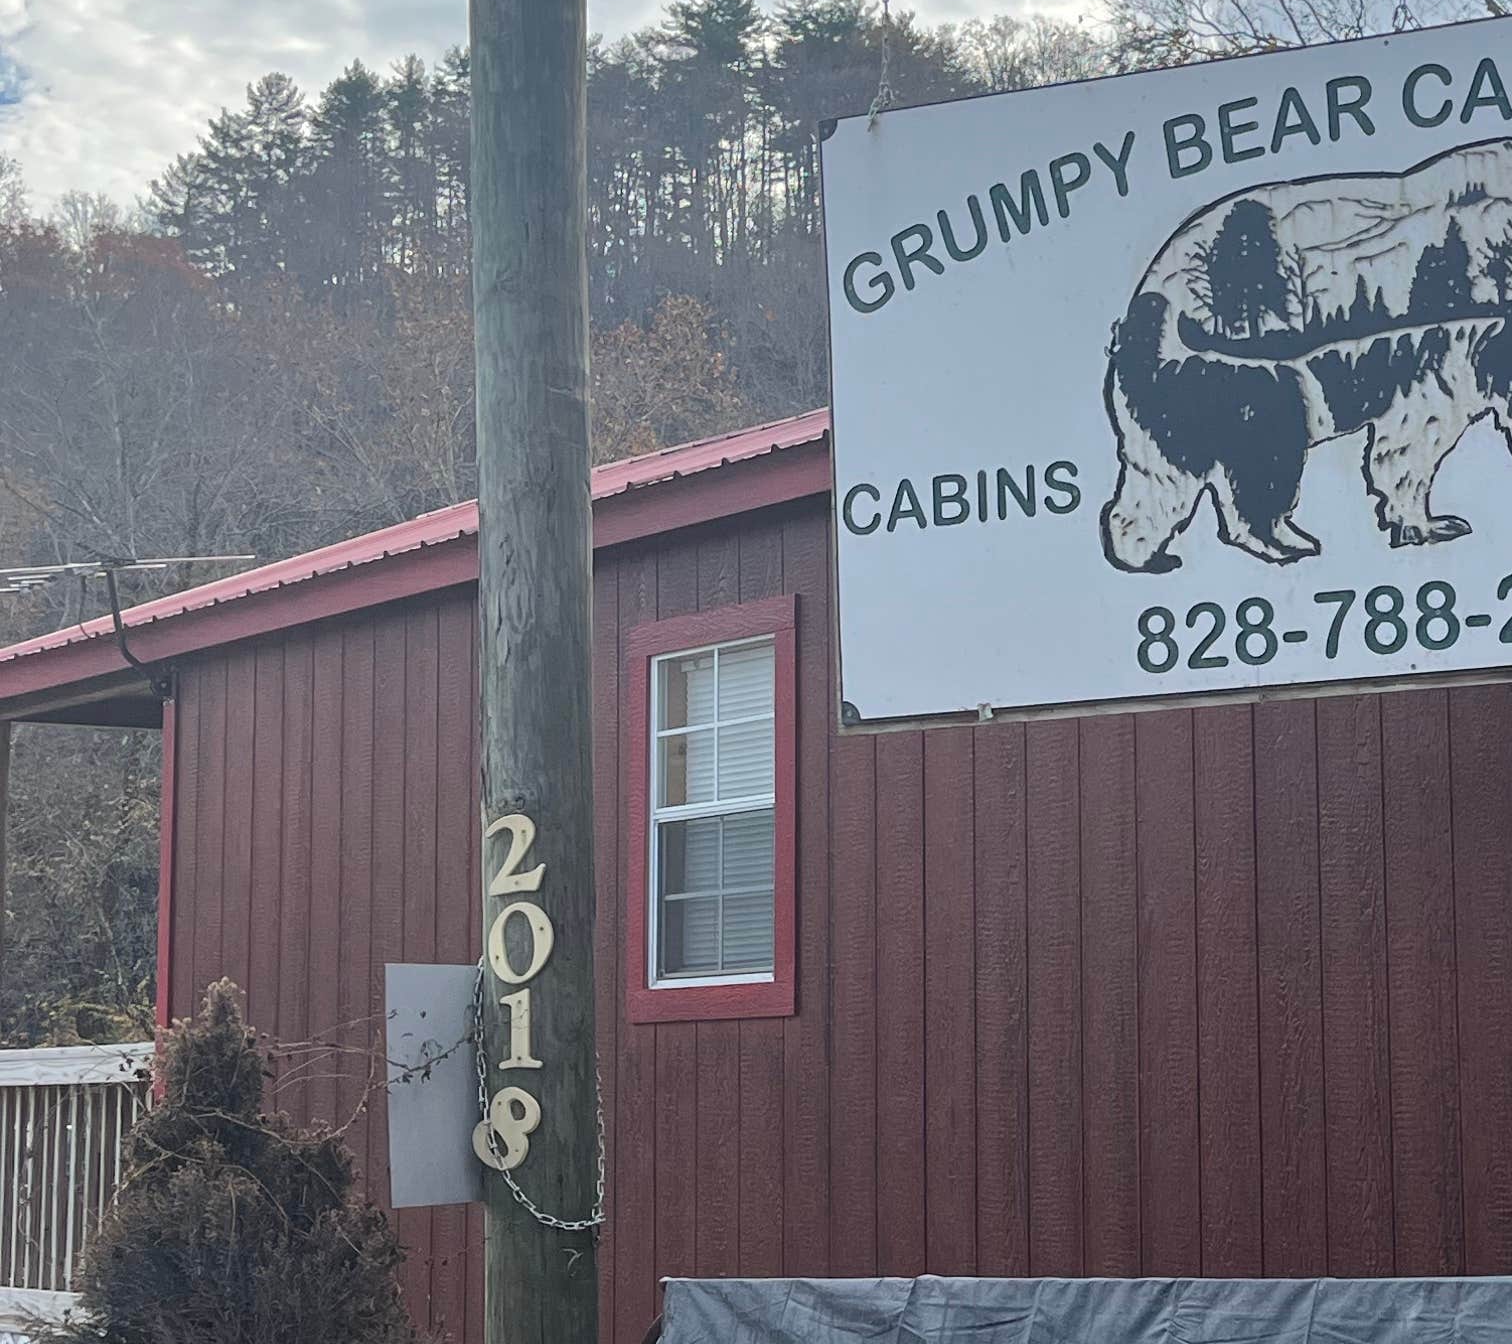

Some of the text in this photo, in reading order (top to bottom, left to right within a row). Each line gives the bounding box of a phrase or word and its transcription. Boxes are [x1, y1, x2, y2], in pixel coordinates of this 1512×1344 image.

[843, 130, 1136, 314] GRUMPY
[1163, 75, 1375, 179] BEAR
[842, 461, 1082, 535] CABINS
[472, 814, 555, 1171] 2018
